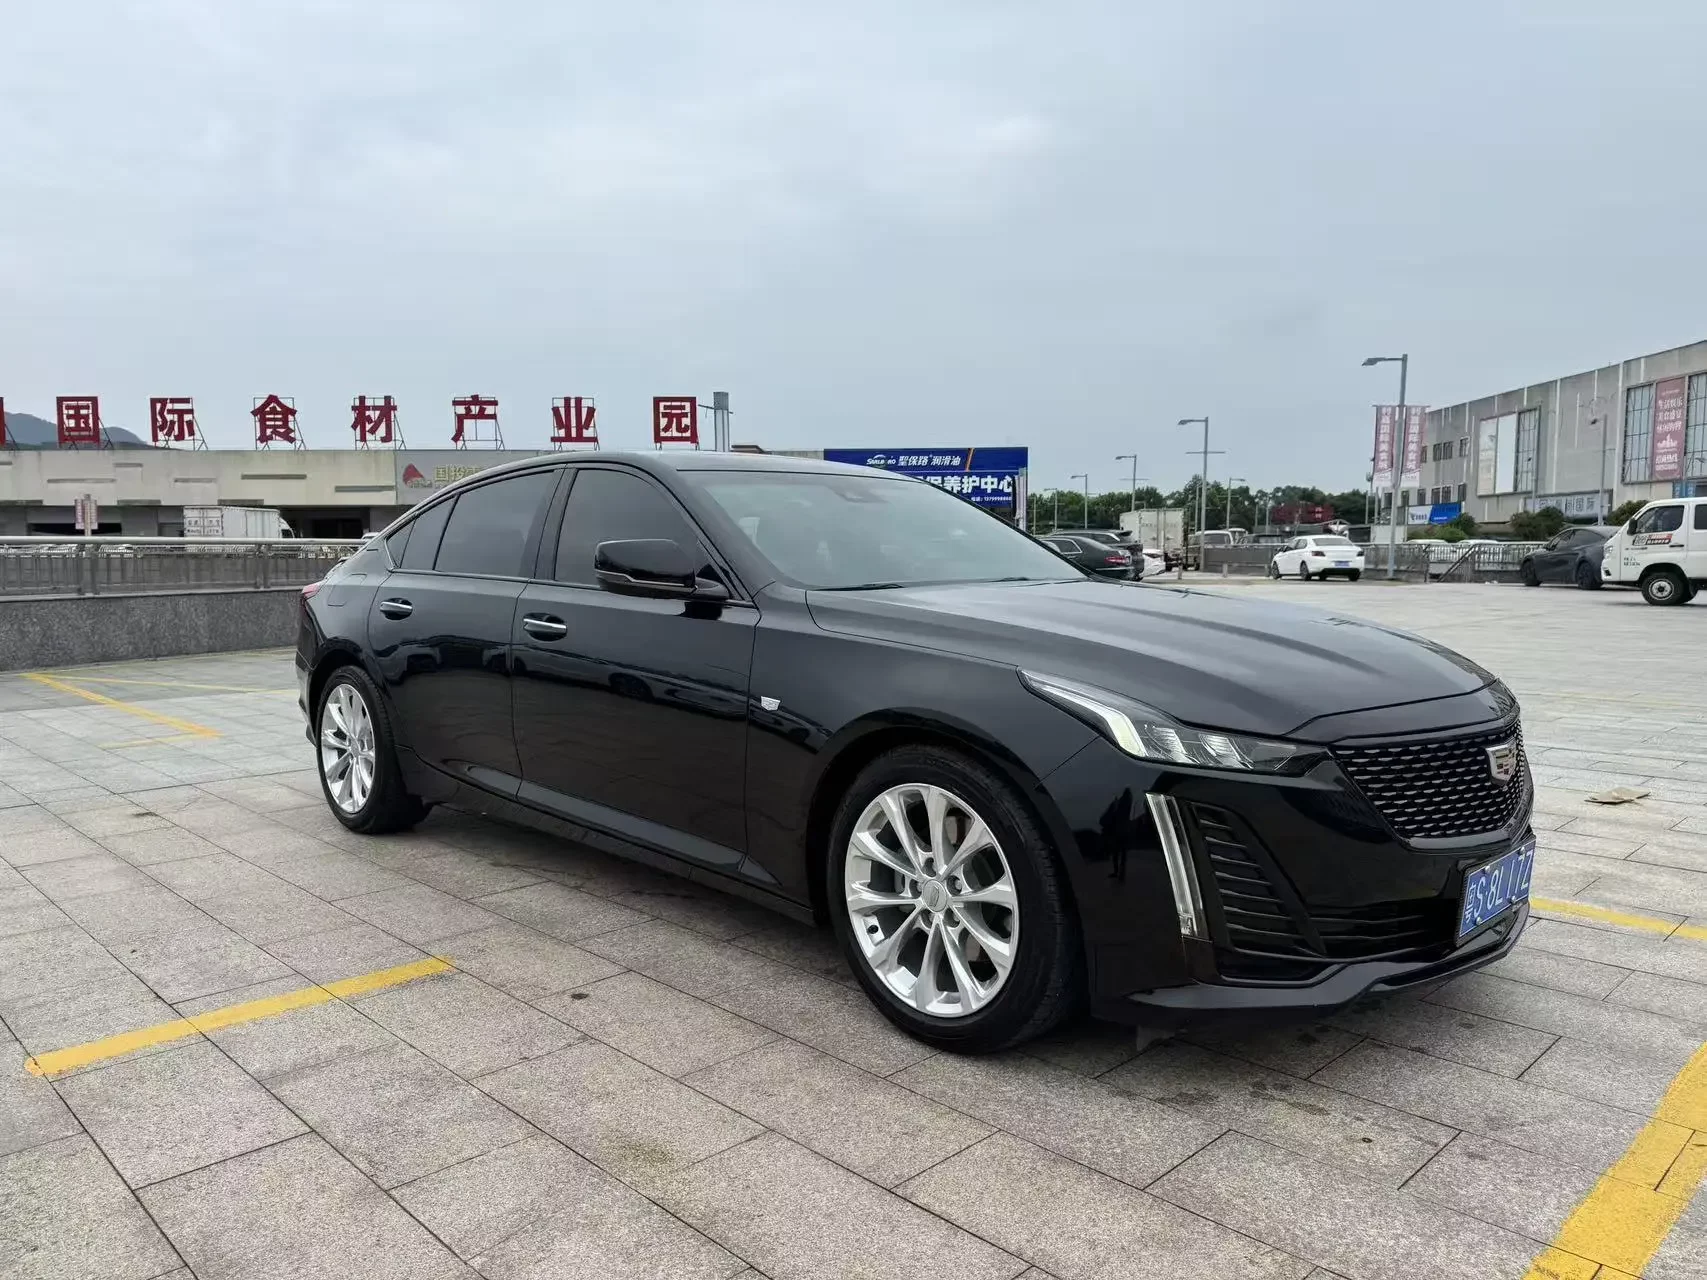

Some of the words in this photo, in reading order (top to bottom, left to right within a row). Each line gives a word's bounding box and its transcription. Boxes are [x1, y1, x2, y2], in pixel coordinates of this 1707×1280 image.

[0, 394, 698, 446] 国际食材产业园
[916, 475, 1013, 494] 保养护中心
